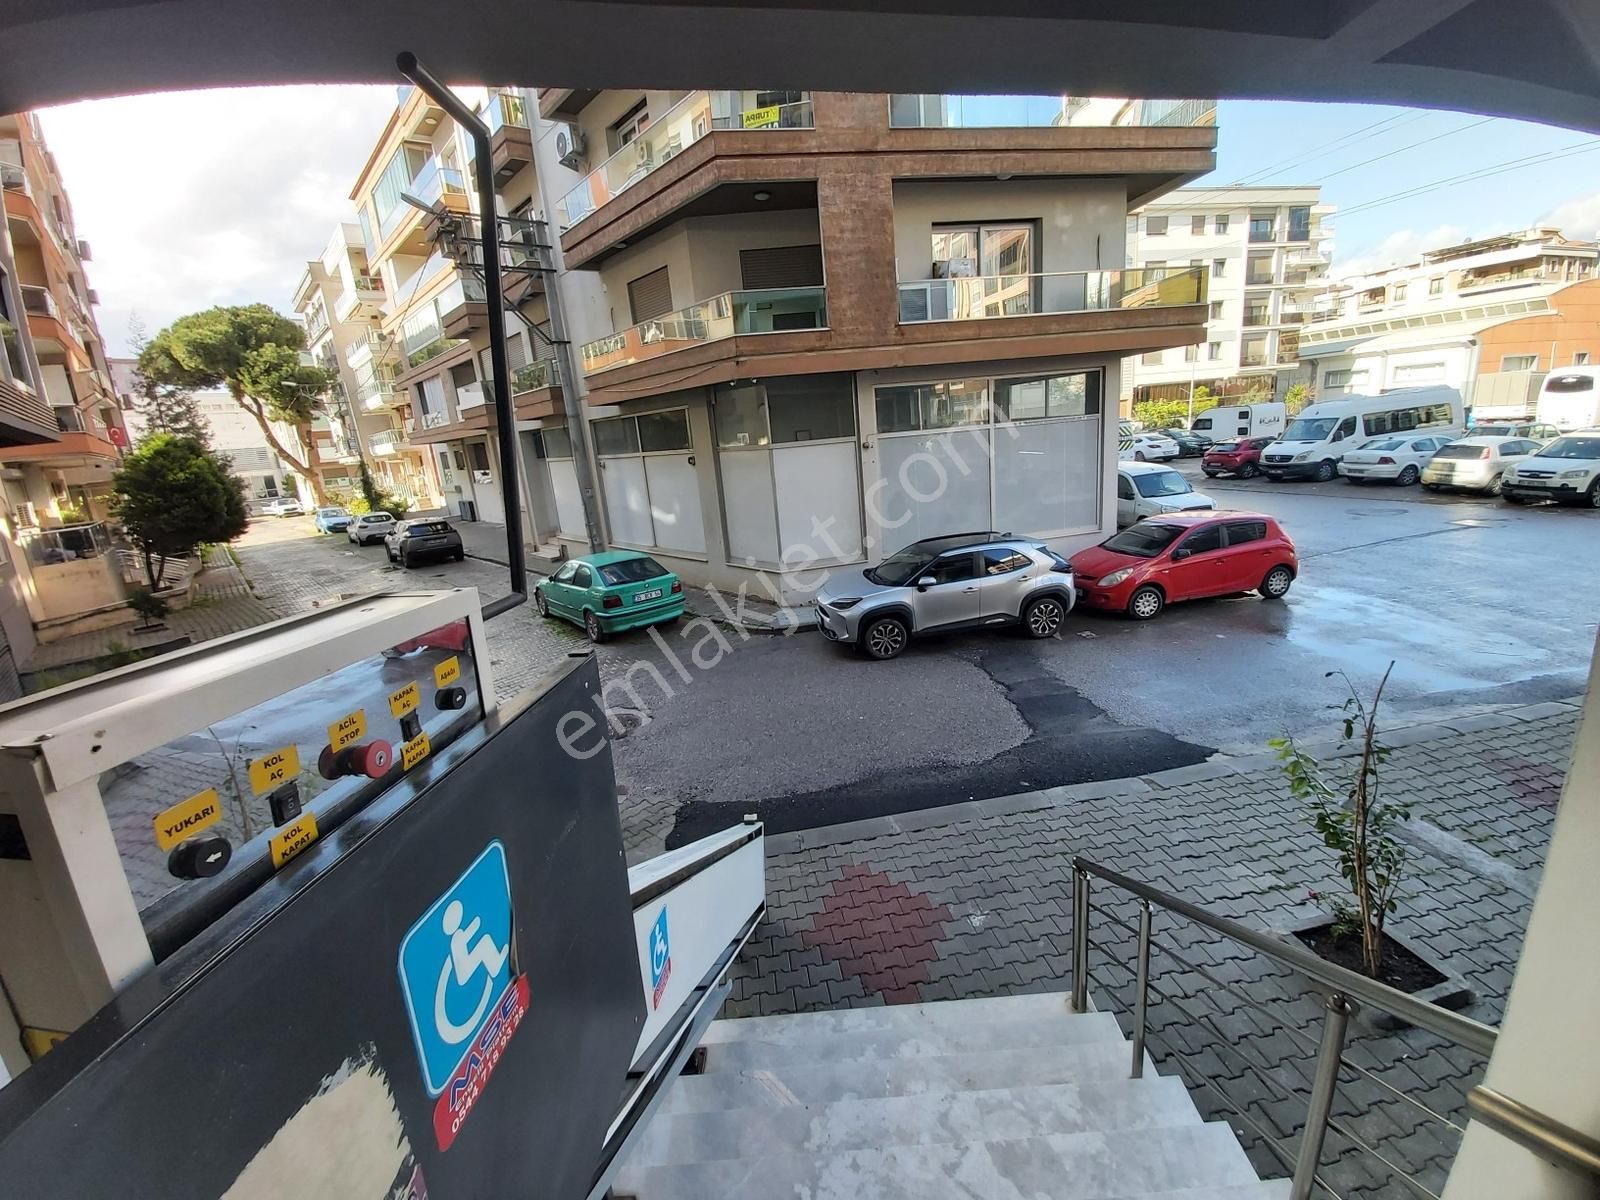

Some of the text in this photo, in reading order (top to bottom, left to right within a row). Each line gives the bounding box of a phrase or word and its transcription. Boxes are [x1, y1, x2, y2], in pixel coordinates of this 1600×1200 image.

[393, 686, 414, 702] KAPAK
[402, 700, 411, 709] AÇ
[339, 728, 361, 745] STOP
[405, 737, 425, 753] KAPAK
[264, 754, 284, 769] KOL
[408, 748, 426, 764] KAPAT
[269, 769, 284, 782] AÇ
[164, 804, 215, 838] YUKARI
[283, 825, 303, 843] KOL
[281, 832, 311, 860] KAPAT
[449, 985, 520, 1114] MSE
[451, 1088, 479, 1133] 0544
